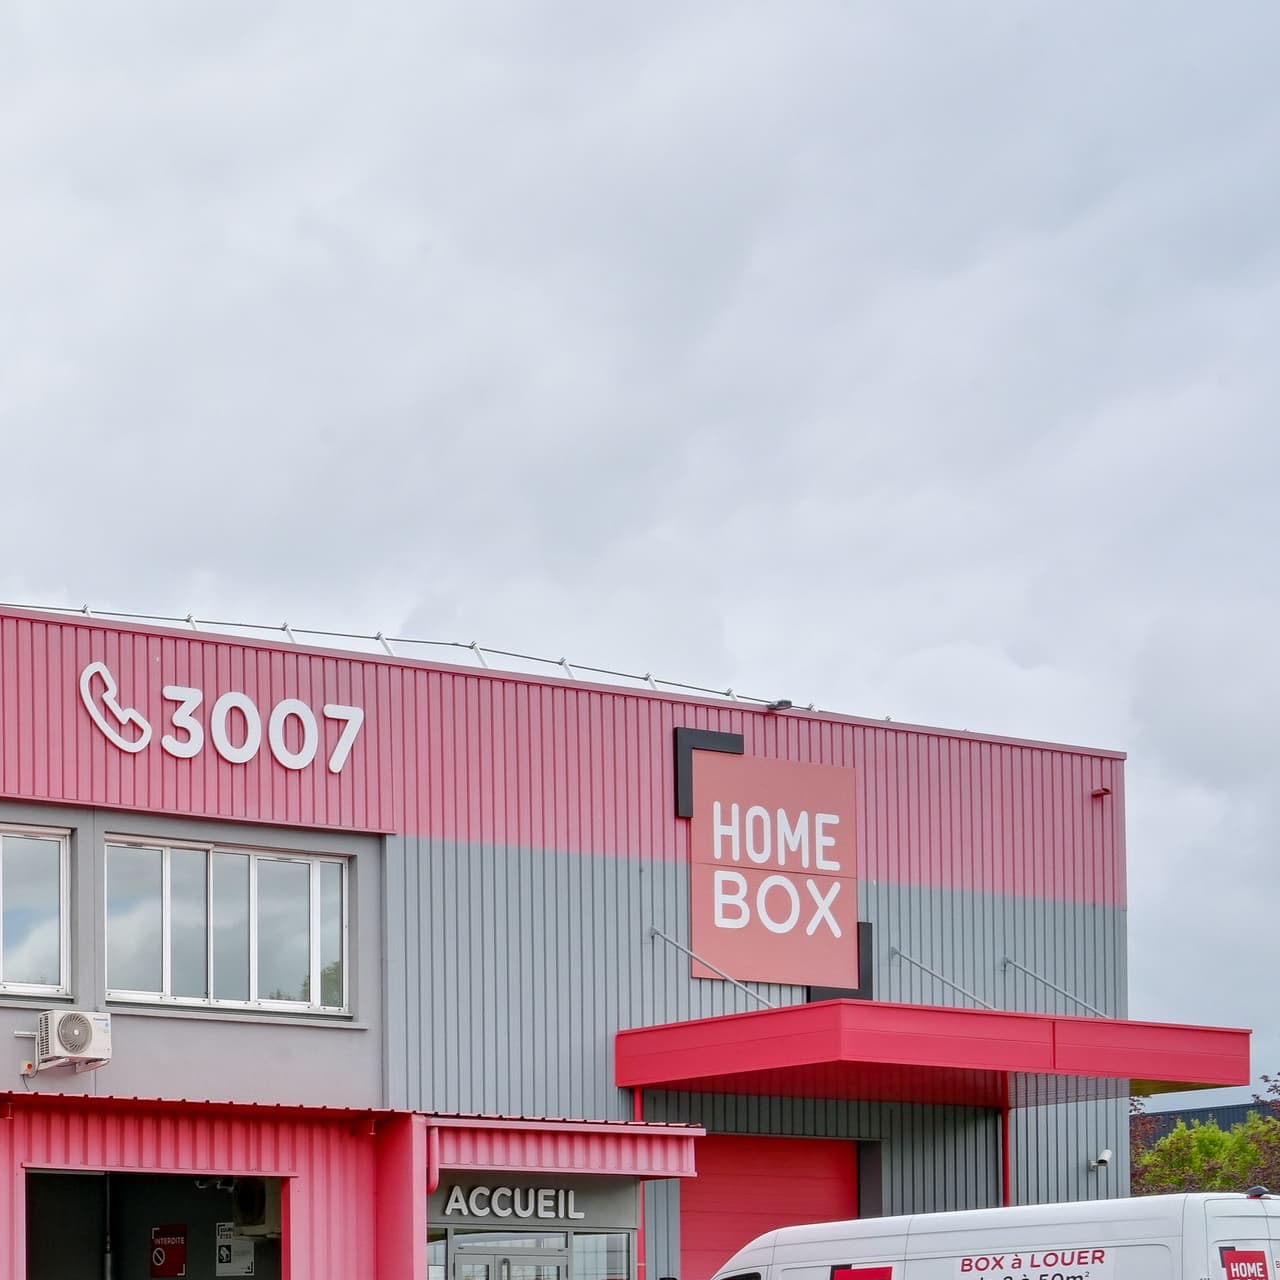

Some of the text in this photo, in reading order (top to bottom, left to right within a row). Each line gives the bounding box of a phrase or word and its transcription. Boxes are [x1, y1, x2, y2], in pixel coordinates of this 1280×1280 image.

[161, 685, 365, 774] 3007
[712, 800, 841, 872] HOME
[713, 870, 842, 938] BOX
[444, 1185, 585, 1219] ACCUEIL
[960, 1249, 1106, 1272] BOX à LOUER
[1230, 1262, 1265, 1278] HOME
